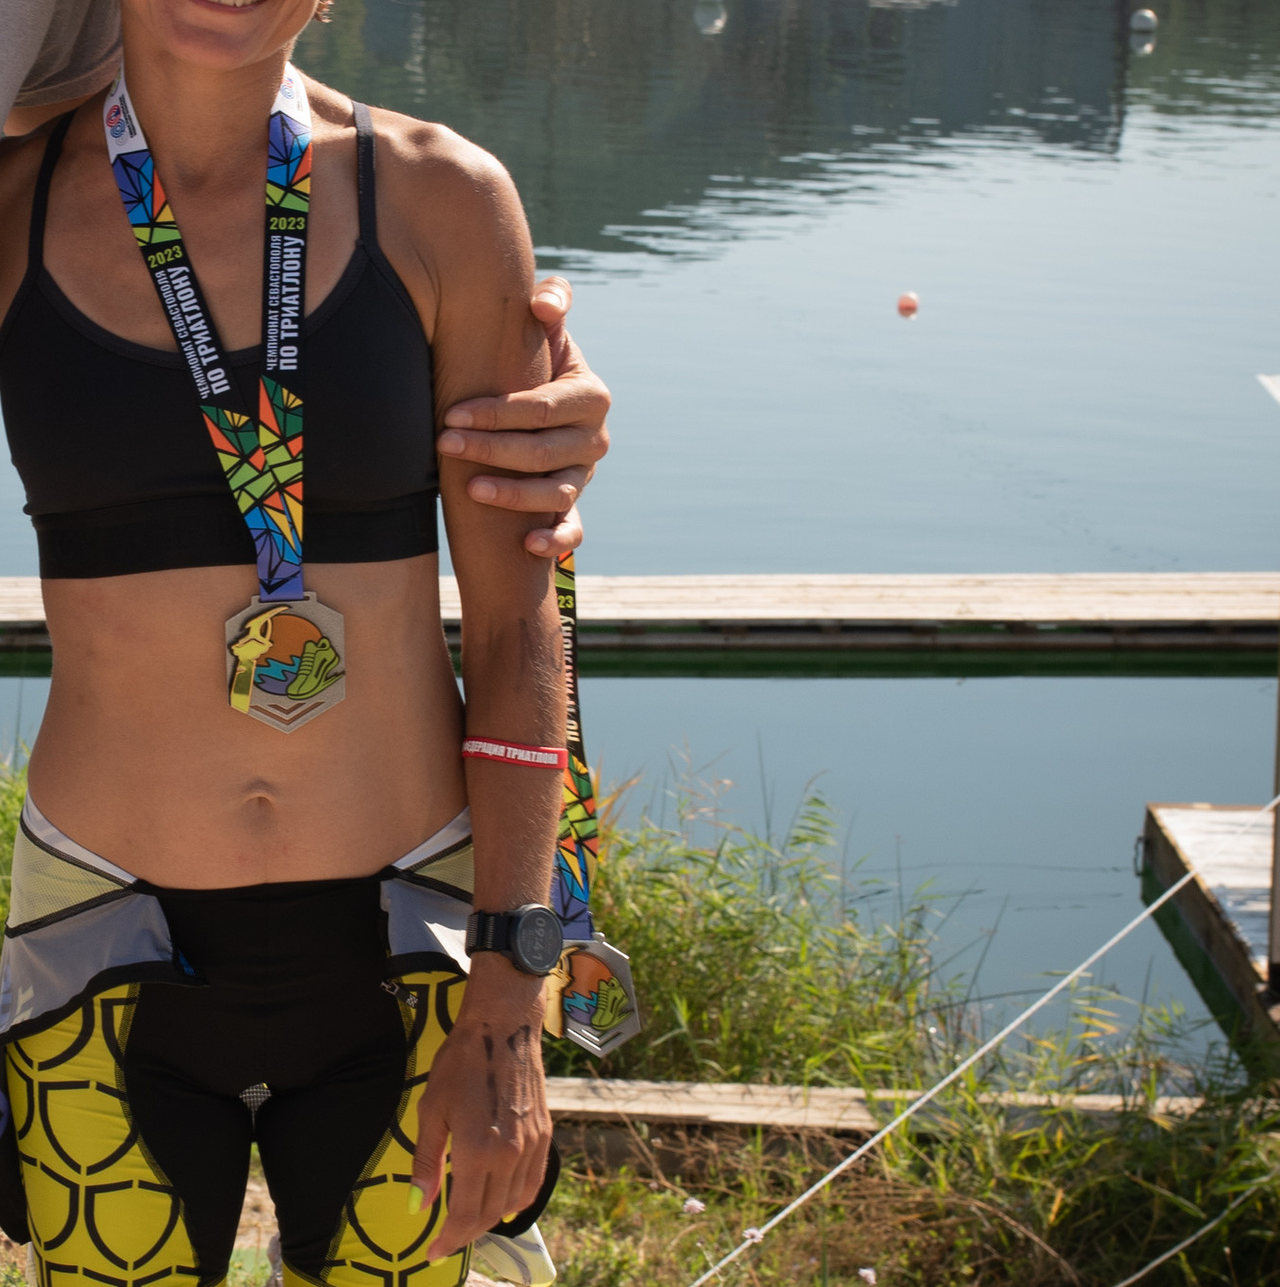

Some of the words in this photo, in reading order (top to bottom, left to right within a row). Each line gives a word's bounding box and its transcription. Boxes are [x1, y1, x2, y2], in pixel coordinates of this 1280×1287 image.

[269, 216, 305, 231] 2023
[147, 245, 183, 269] 2023
[269, 234, 282, 307] СЕВАСТОПОЛЯ
[280, 235, 305, 341] ТРИАТЛОНУ
[154, 269, 189, 339] СЕВАСТОПОЛЯ
[167, 265, 220, 367] ТРИАТЛОНУ
[180, 338, 211, 400] ЧЕМПИОНАТ
[266, 309, 279, 371] ЧЕМПИОНАТ
[279, 345, 299, 371] ПО
[206, 367, 232, 395] ПО
[557, 595, 575, 609] 23
